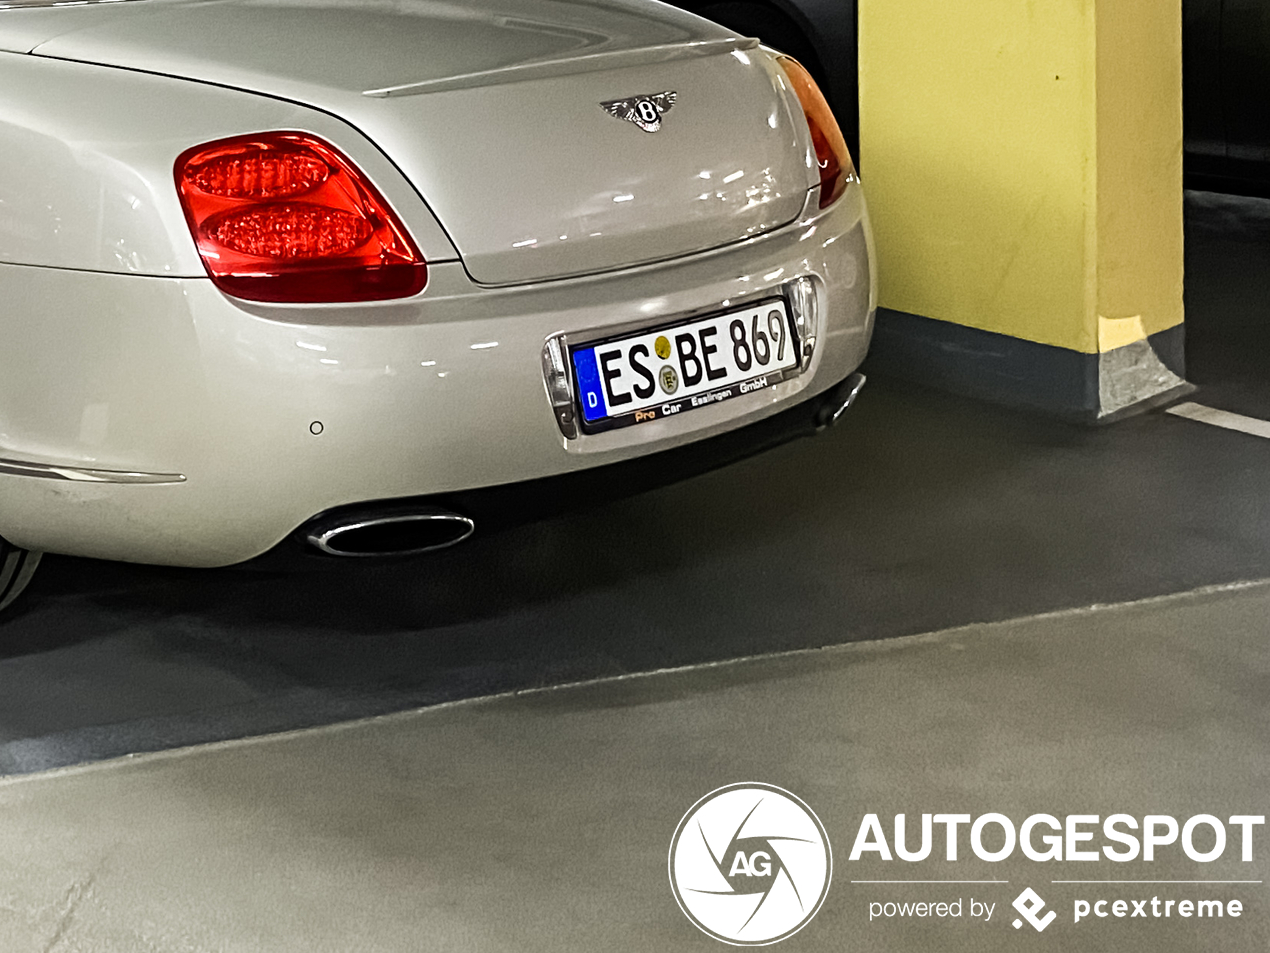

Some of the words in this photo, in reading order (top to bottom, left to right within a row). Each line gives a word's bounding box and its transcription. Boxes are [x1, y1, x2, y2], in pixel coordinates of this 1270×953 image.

[599, 344, 656, 407] ES
[675, 325, 728, 388] BE
[730, 309, 786, 372] 869
[587, 391, 598, 408] D
[635, 410, 656, 422] Pro
[661, 403, 682, 416] Car
[739, 376, 768, 394] GmbH
